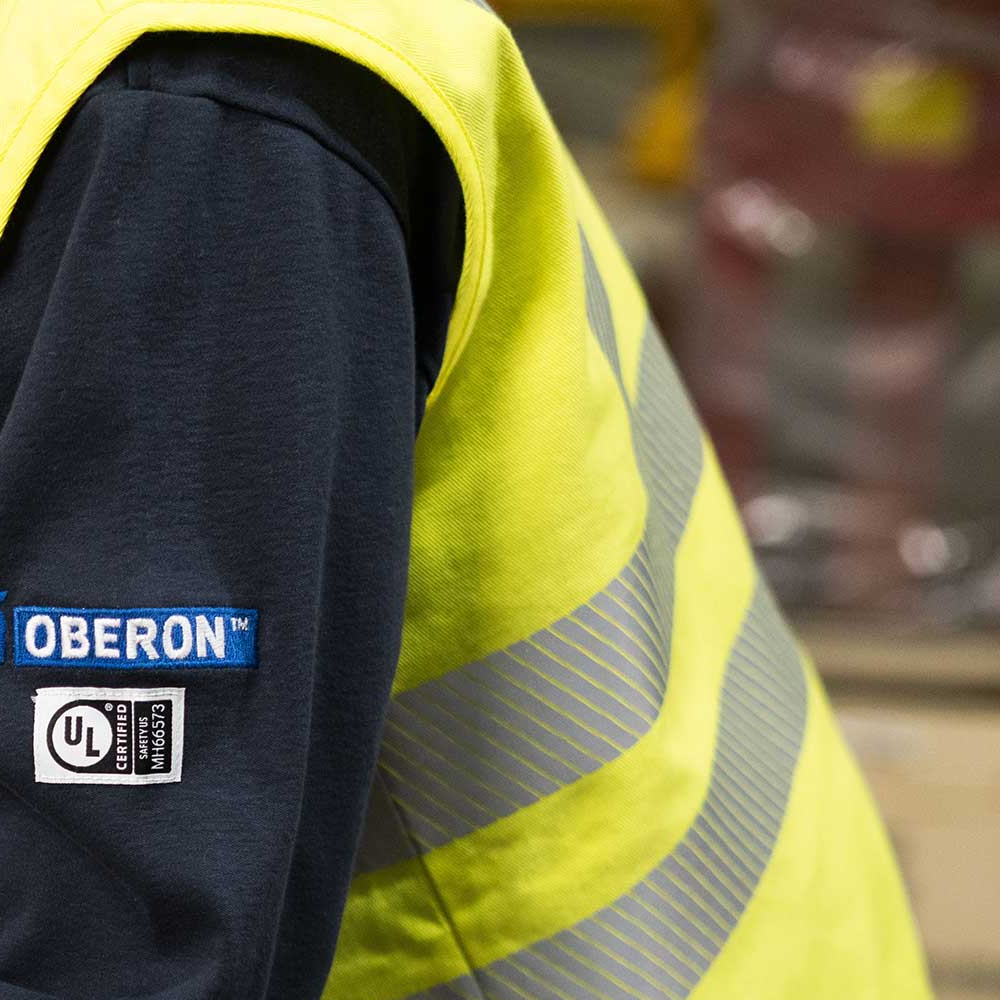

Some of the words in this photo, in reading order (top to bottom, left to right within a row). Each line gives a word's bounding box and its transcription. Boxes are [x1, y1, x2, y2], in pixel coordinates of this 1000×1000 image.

[65, 716, 100, 757] UL
[116, 704, 128, 771] CERTIFIED
[151, 704, 166, 770] MH66573
